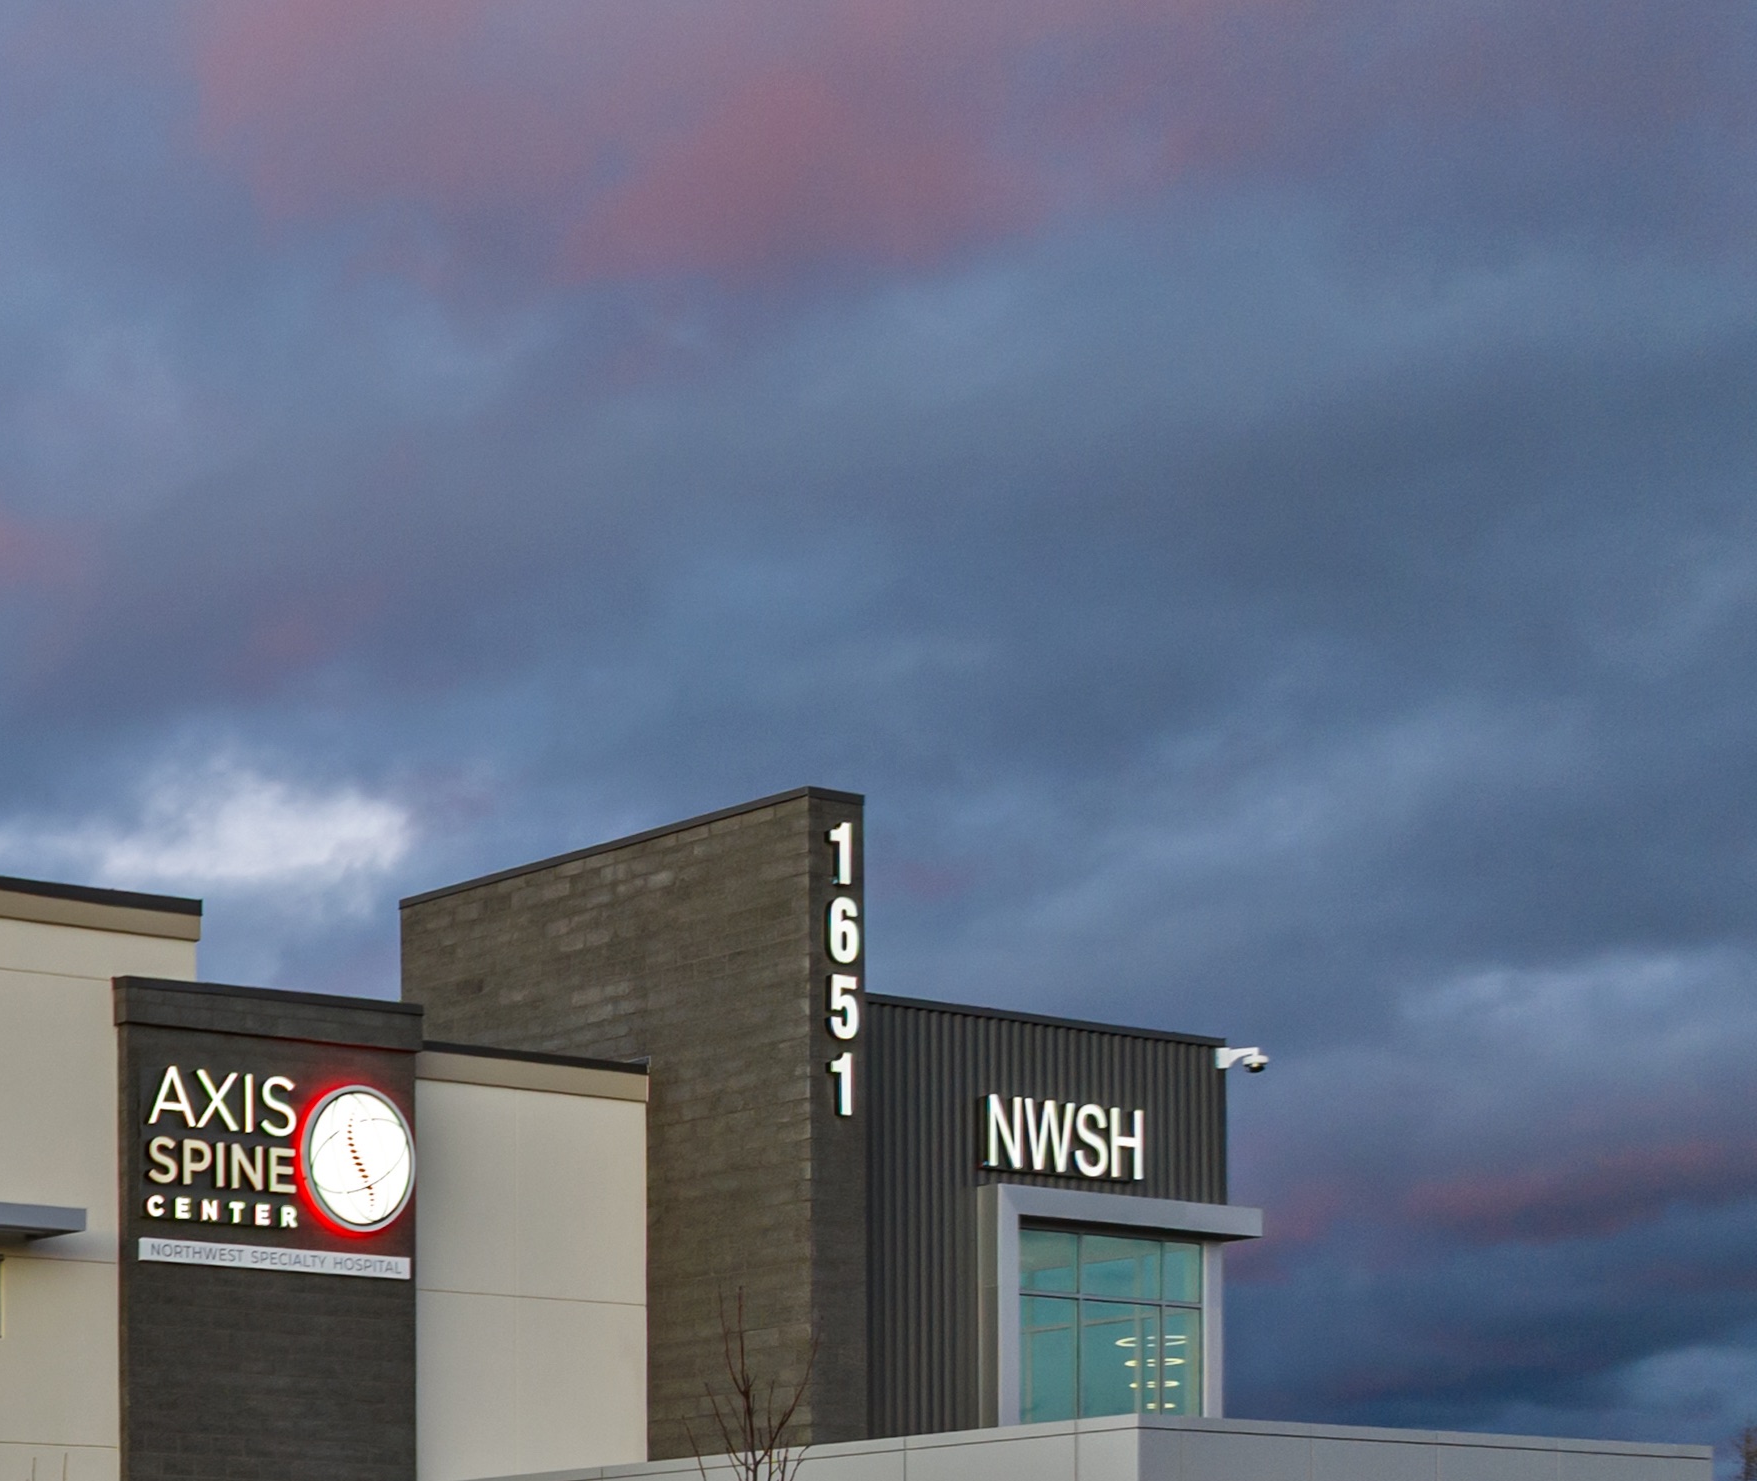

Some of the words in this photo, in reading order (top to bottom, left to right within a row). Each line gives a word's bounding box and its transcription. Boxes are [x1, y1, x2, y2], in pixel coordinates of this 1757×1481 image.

[829, 822, 859, 1116] 1651
[148, 1065, 297, 1136] AXIS
[148, 1135, 297, 1194] SPINE
[988, 1093, 1144, 1180] NWSH
[146, 1195, 298, 1228] CENTER
[150, 1243, 244, 1263] NORTHWEST
[251, 1252, 327, 1269] SPECIALTY
[334, 1258, 402, 1275] HOSPITAL
